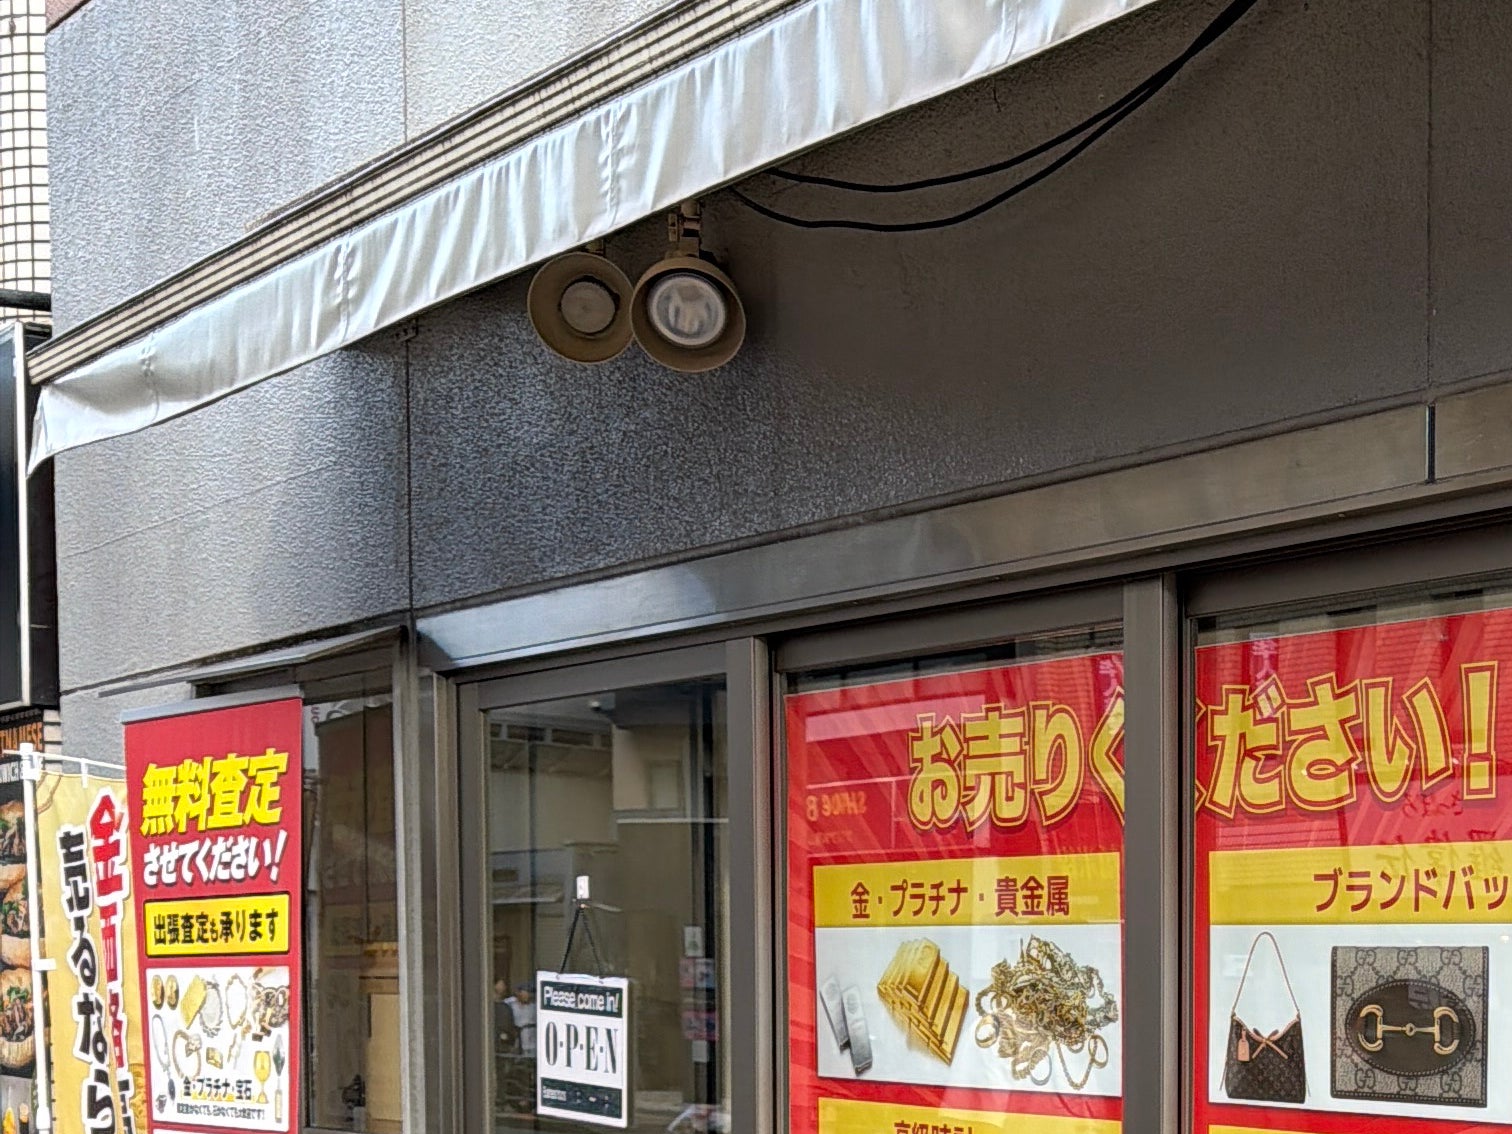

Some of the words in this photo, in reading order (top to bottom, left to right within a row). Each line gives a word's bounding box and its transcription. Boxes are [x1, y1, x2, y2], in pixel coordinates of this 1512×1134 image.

[141, 748, 289, 837] 無料査定
[144, 830, 287, 887] させてください!
[851, 875, 1069, 919] 金・プラチナ・貴金属
[153, 910, 279, 945] 出張査定も承ります
[543, 986, 576, 1008] Please
[577, 992, 605, 1011] come
